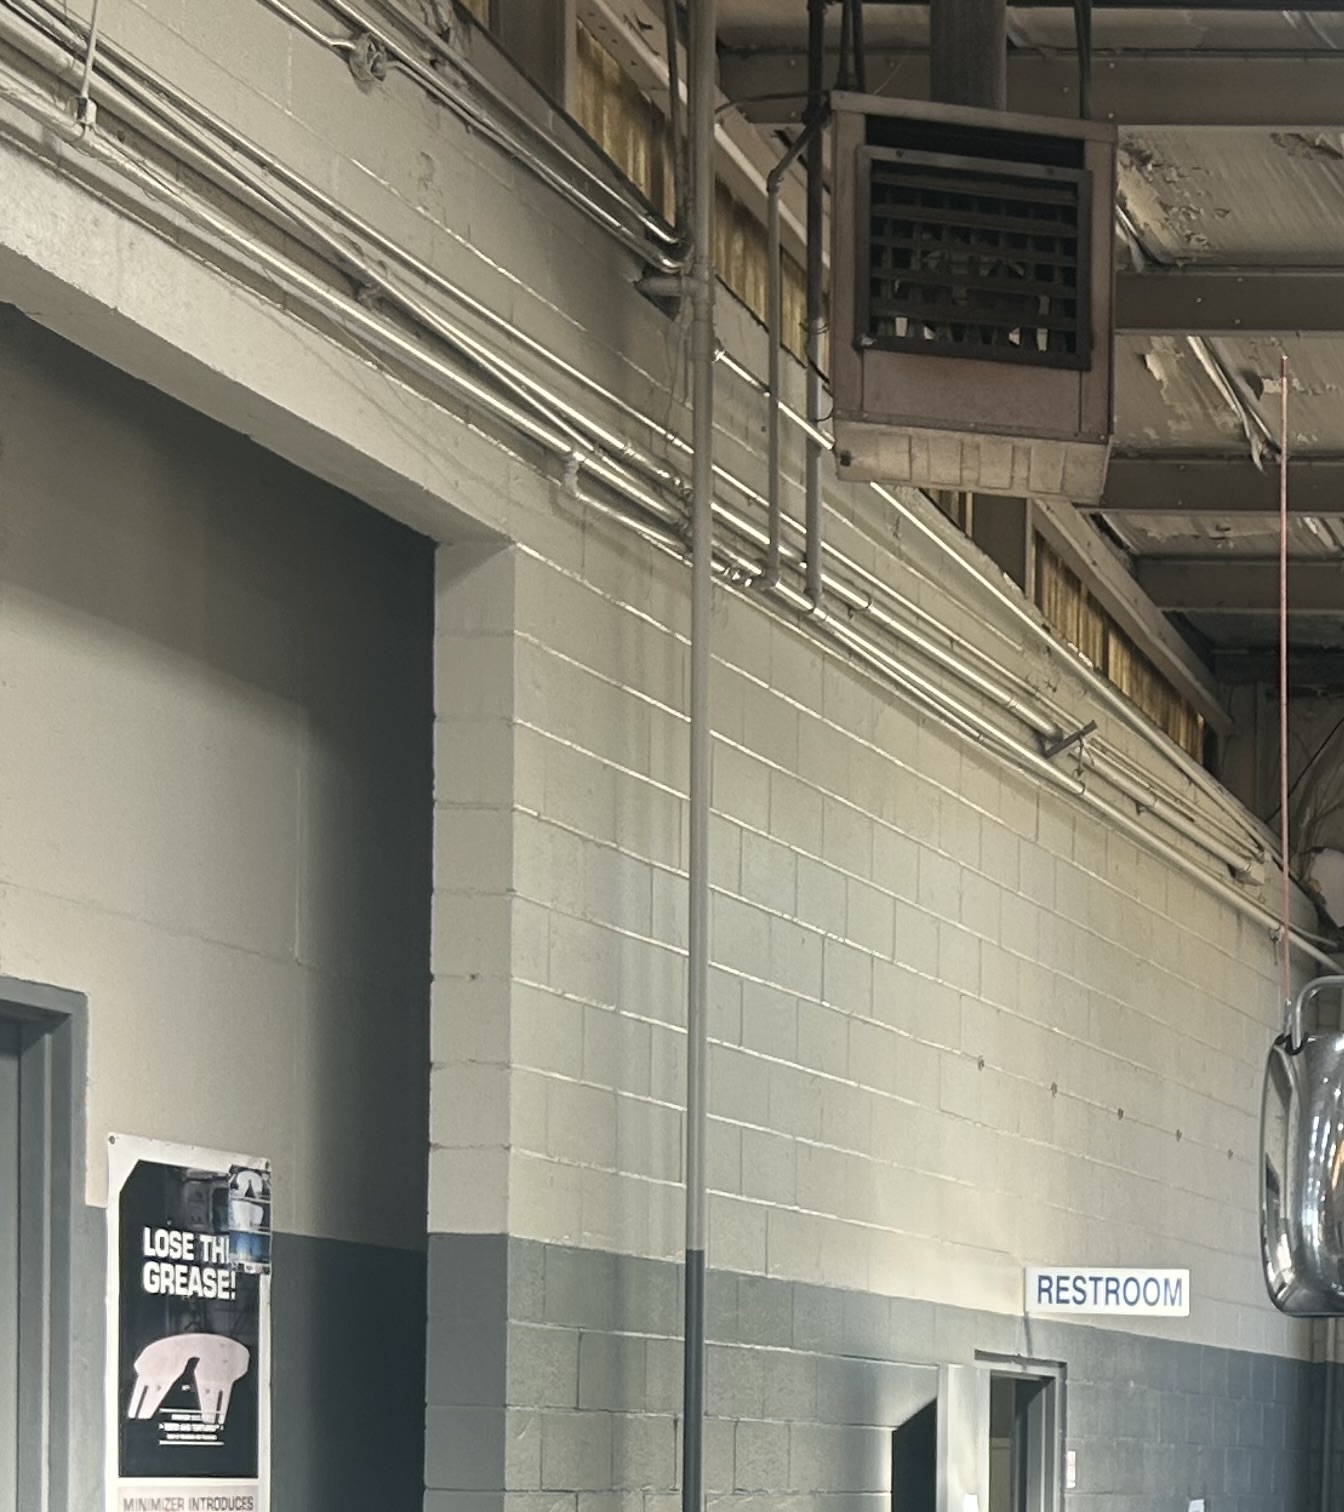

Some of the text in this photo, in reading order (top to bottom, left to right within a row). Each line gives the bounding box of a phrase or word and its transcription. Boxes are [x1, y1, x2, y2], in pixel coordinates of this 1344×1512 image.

[143, 1226, 229, 1264] LOSE TH
[143, 1260, 236, 1300] GREASE!
[1037, 1274, 1183, 1307] RESTROOM
[123, 1495, 254, 1512] MINIMIZER INTRODUCES
